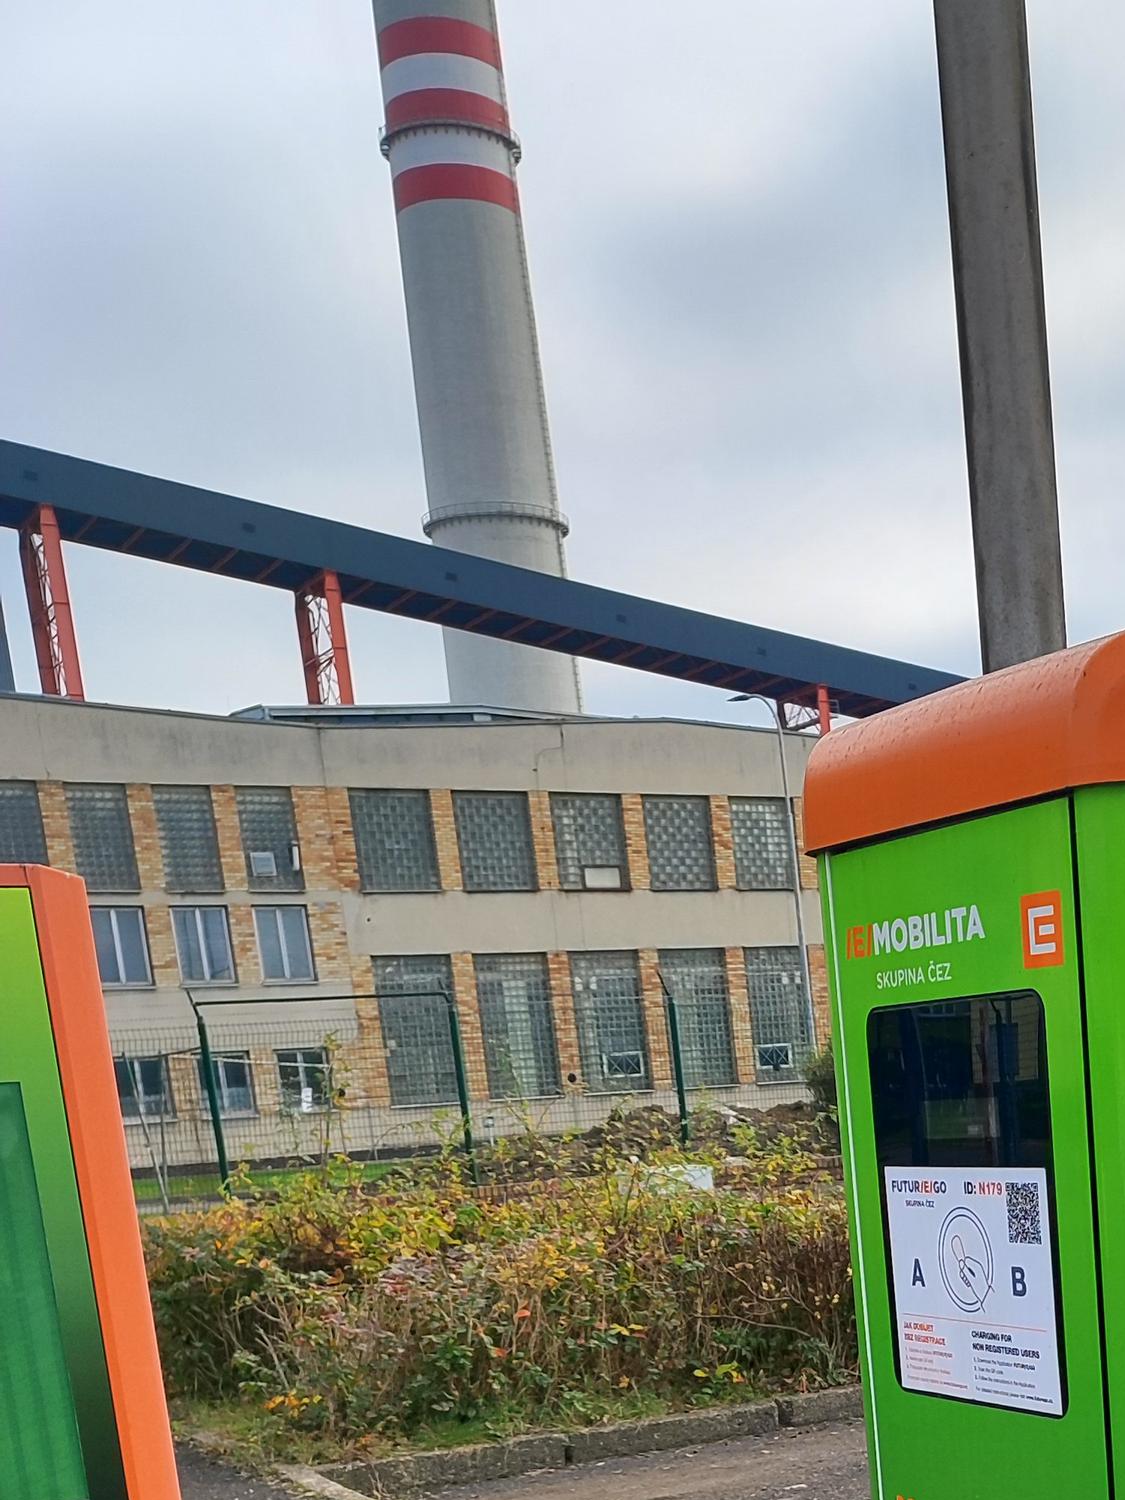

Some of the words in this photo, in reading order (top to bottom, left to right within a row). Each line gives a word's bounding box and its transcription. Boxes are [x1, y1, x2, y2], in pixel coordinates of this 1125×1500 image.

[876, 966, 925, 989] SKUPINA
[928, 961, 952, 982] ČEZ
[963, 1181, 977, 1195] ID:
[978, 1182, 1003, 1196] N179
[911, 1258, 926, 1287] A
[1011, 1266, 1027, 1297] B
[971, 1331, 1000, 1342] CHARGING
[1001, 1334, 1012, 1343] FOR
[972, 1343, 984, 1351] NON
[985, 1344, 1019, 1356] REGISTERED
[1021, 1349, 1040, 1359] USERS
